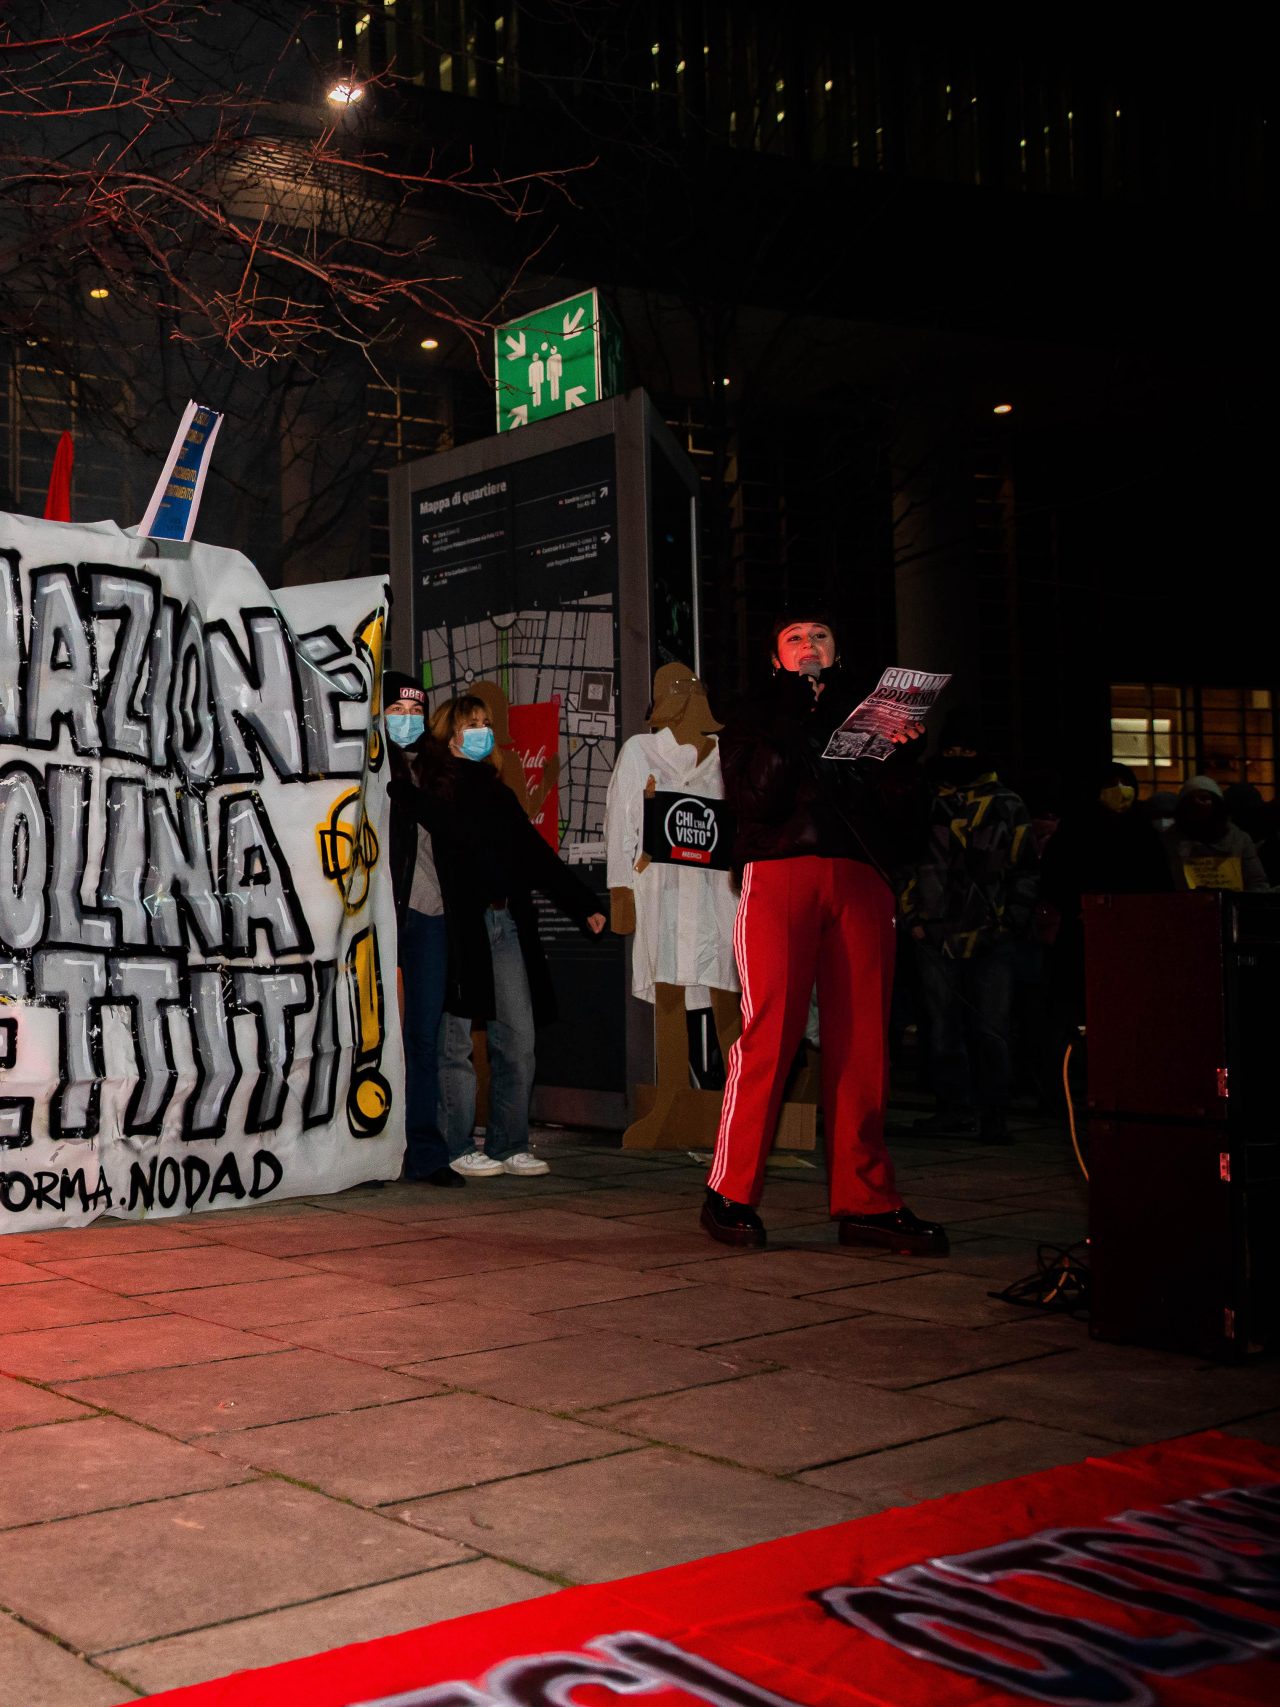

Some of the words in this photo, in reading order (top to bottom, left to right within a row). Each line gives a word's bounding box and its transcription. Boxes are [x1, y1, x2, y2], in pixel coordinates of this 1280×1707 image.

[419, 497, 450, 515] Mappa
[451, 490, 461, 506] di
[462, 481, 507, 506] quartiere
[402, 688, 426, 704] OBEY
[675, 809, 693, 827] CHI
